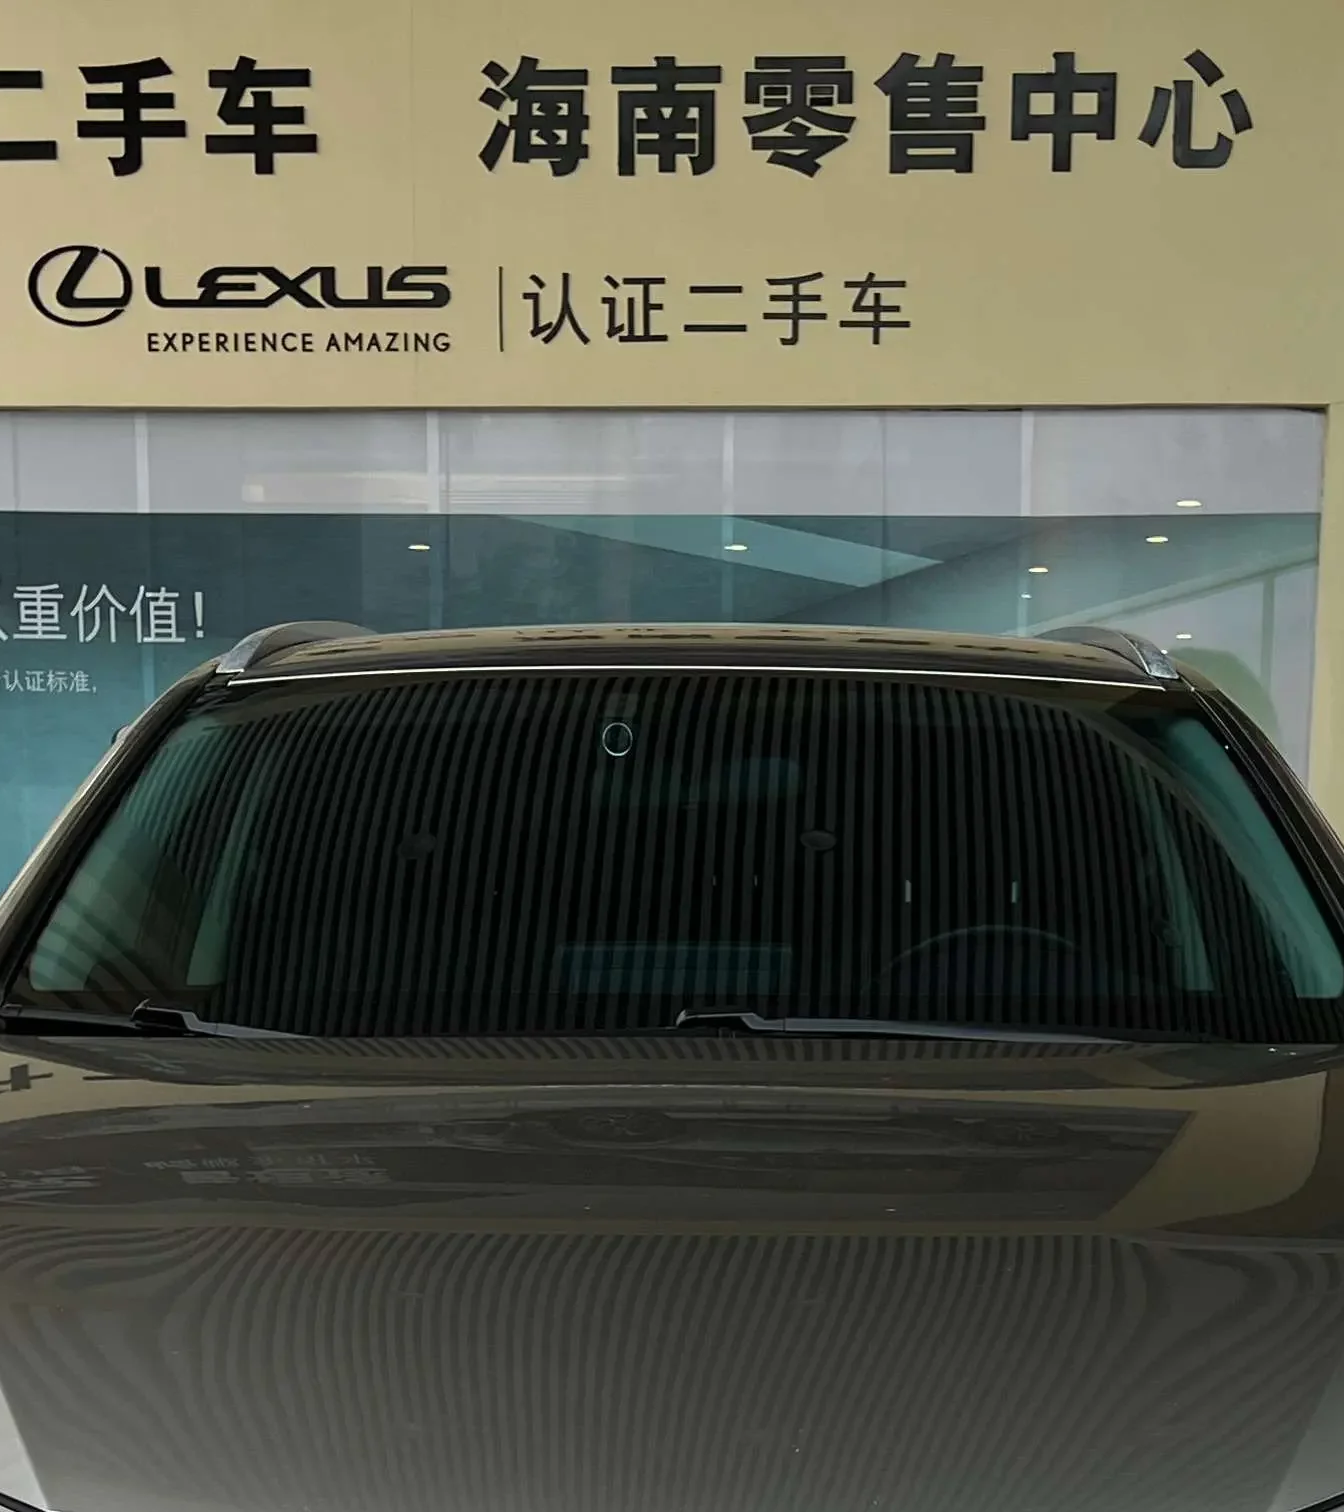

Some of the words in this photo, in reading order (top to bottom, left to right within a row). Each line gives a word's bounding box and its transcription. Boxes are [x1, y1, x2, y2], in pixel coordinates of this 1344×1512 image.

[478, 50, 1254, 179] 海南零售中心
[145, 265, 452, 310] LEXUS
[522, 271, 912, 347] 认证二手车
[147, 332, 315, 354] EXPERIENCE
[325, 332, 453, 354] AMAZING
